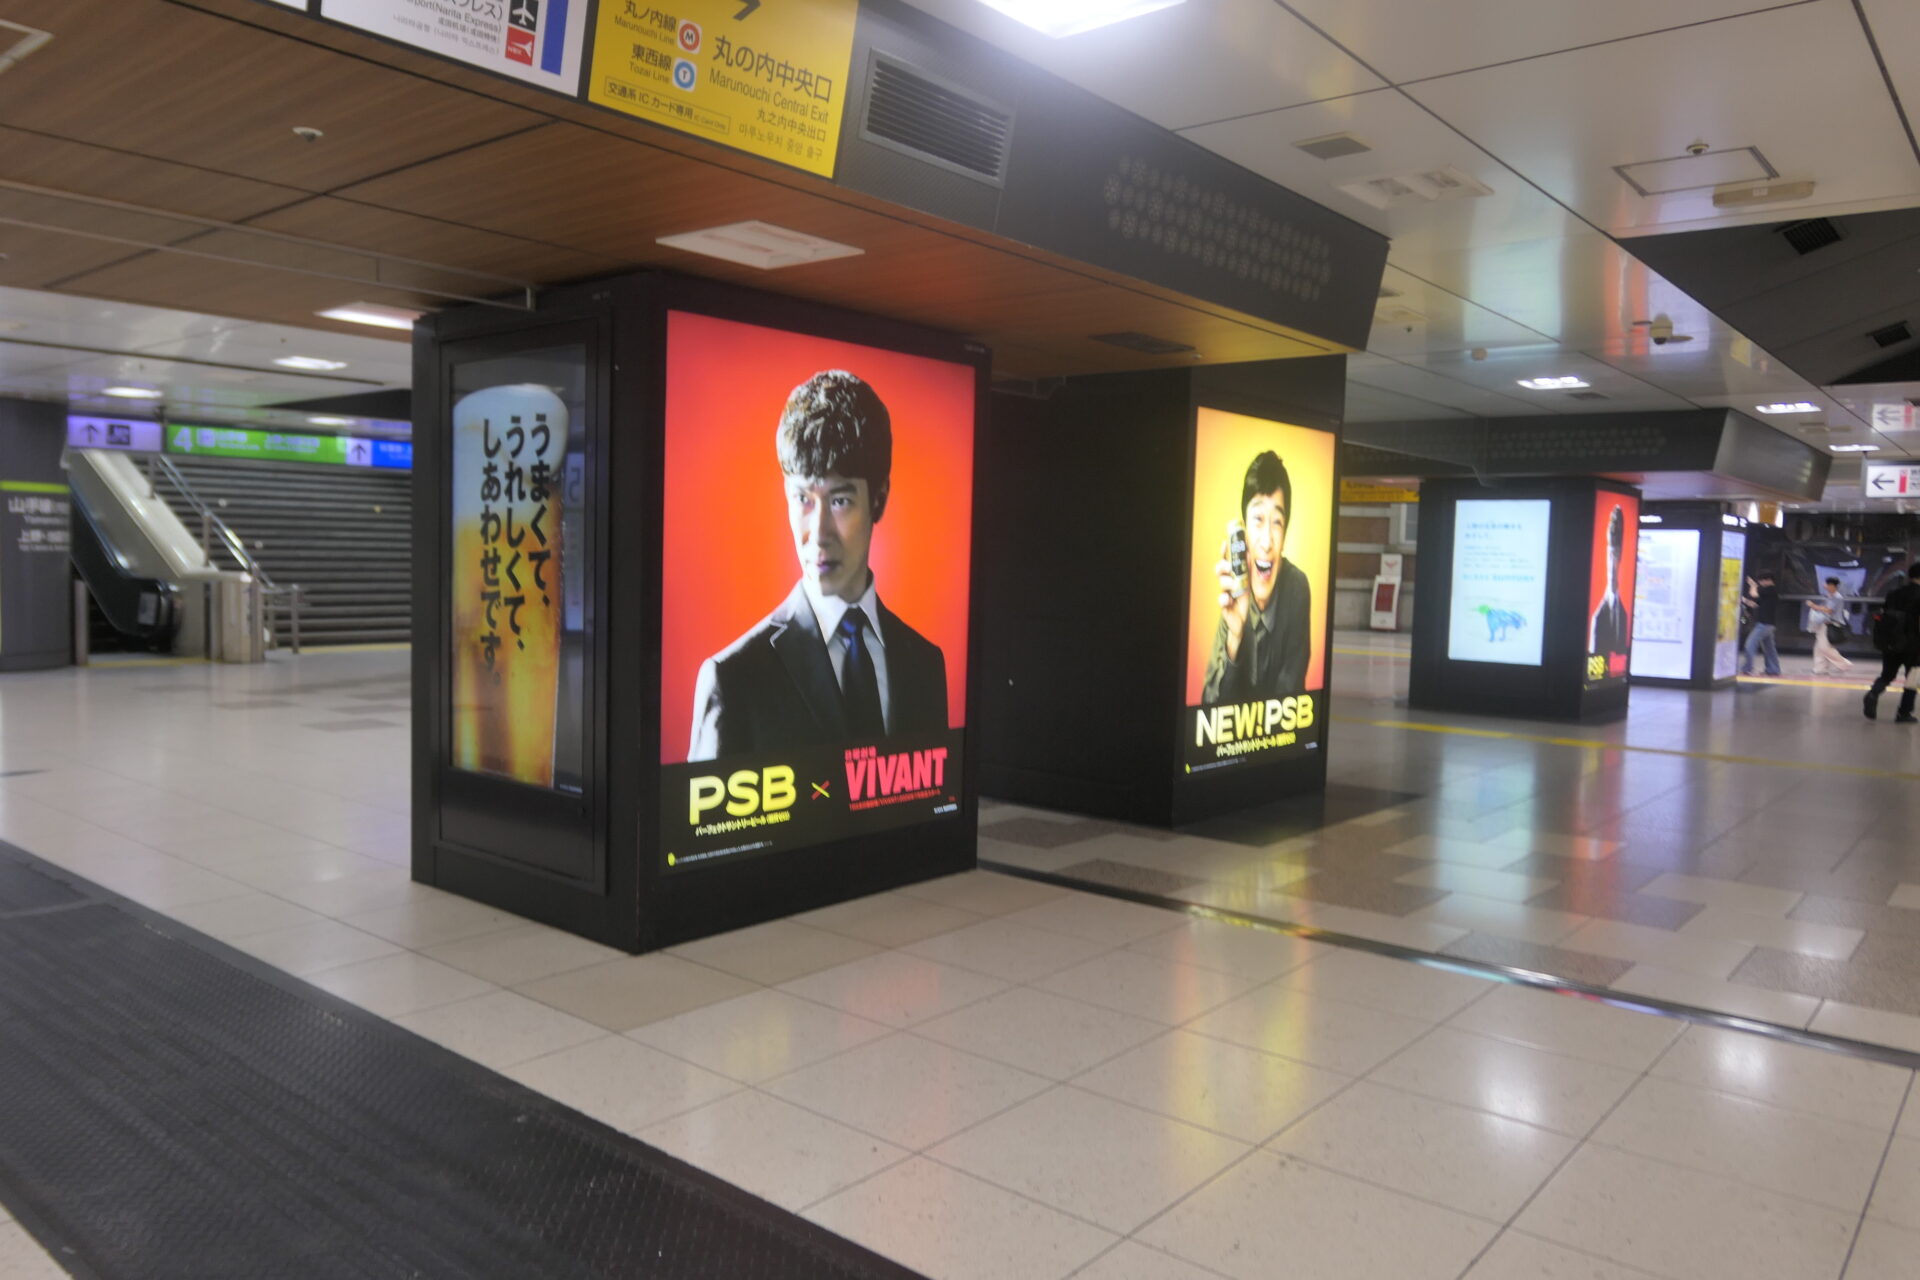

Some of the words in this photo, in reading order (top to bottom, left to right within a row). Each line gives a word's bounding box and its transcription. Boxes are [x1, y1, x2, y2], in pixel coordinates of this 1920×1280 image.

[614, 15, 658, 40] Marunouchi
[659, 34, 676, 46] Line
[624, 0, 678, 32] 丸ノ内線
[629, 60, 651, 78] Tozai
[652, 69, 671, 84] Line
[632, 43, 673, 71] 東西線
[712, 34, 832, 104] 丸の内中央口
[607, 81, 637, 102] 交通系
[638, 90, 650, 105] IC
[709, 67, 771, 104] Marunouchi
[772, 91, 809, 117] Central
[810, 104, 829, 125] Exit
[757, 108, 827, 142] 丸之内中央出口
[174, 426, 194, 453] 4
[528, 413, 551, 607] うまくて、
[480, 418, 502, 687] しあわせです。
[504, 415, 526, 651] うれしくて、
[689, 765, 797, 826] PSB
[844, 746, 949, 802] VIVANT
